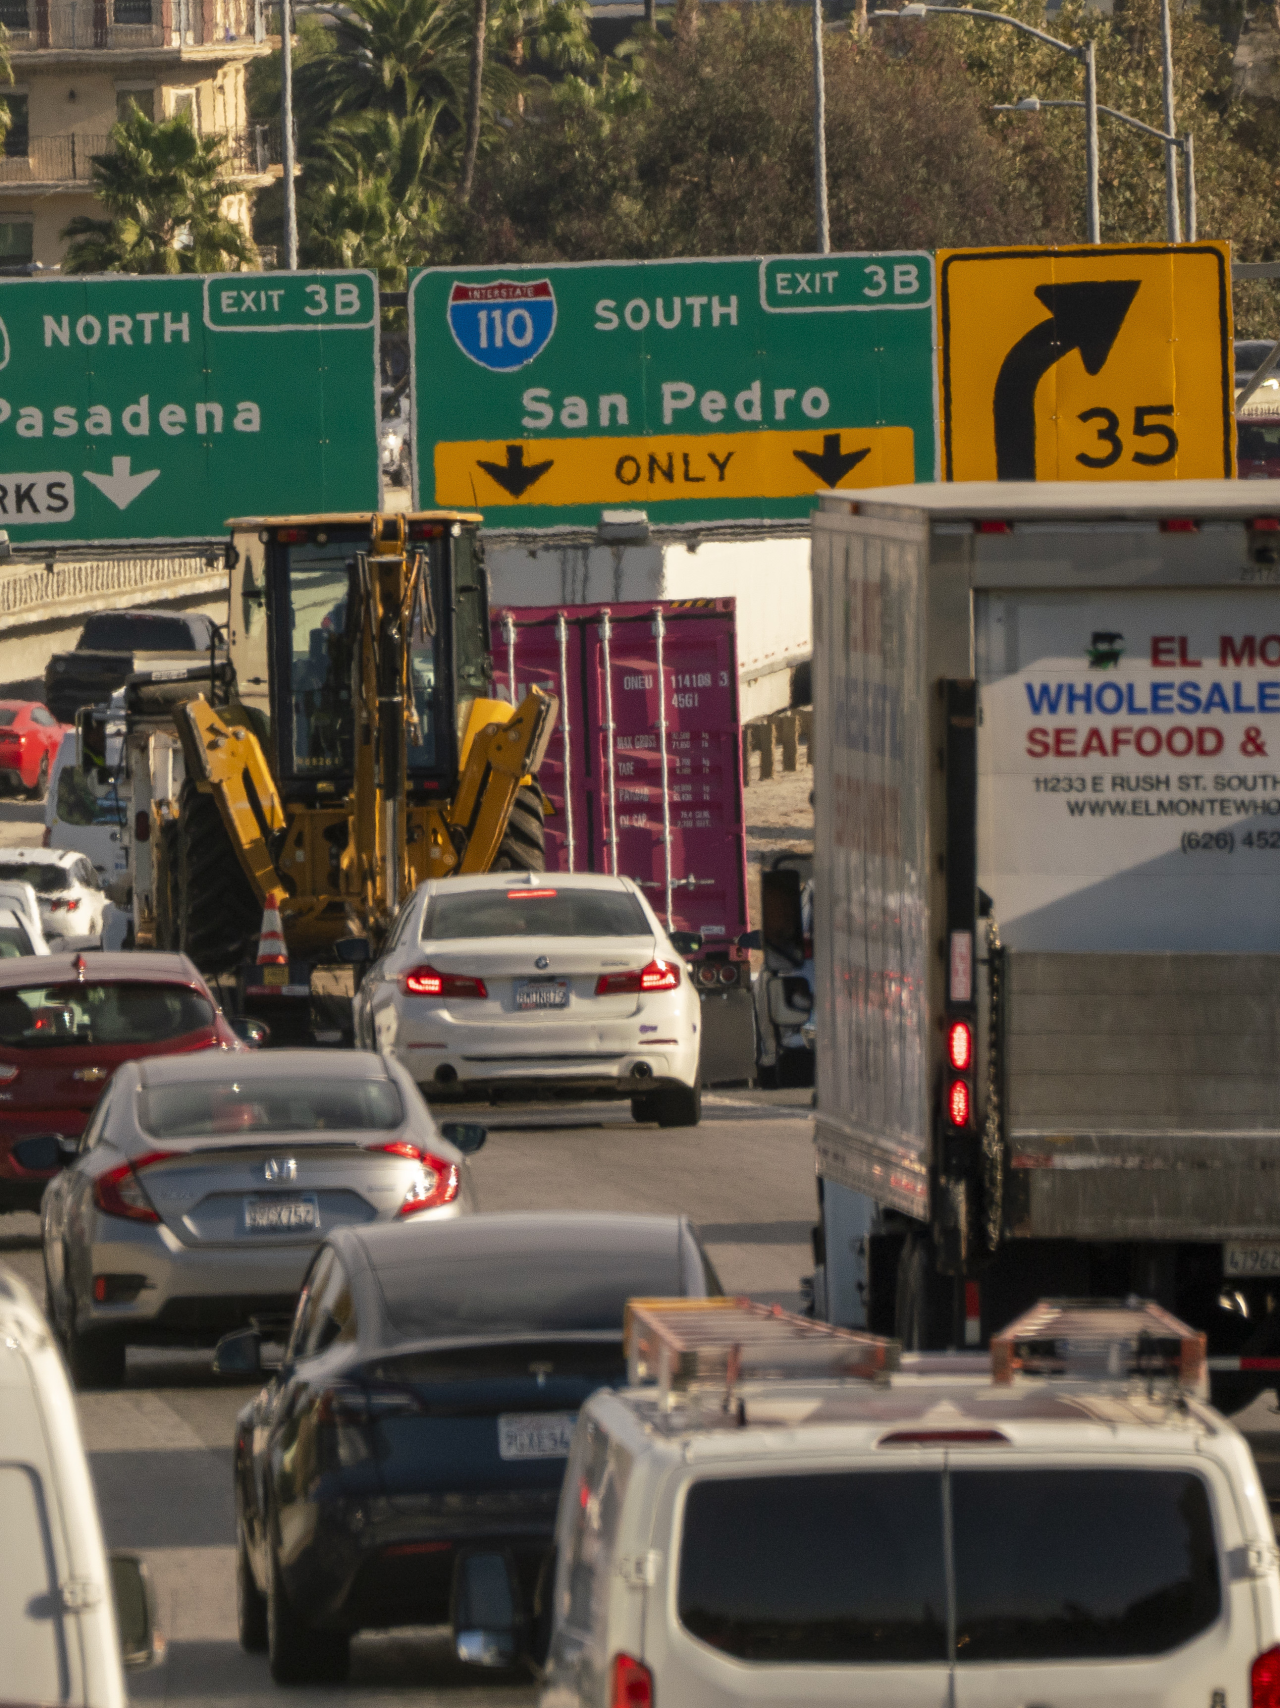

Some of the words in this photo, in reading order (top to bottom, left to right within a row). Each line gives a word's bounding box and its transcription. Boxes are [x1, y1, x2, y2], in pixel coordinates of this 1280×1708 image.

[468, 287, 535, 298] INTERSTATE
[776, 271, 838, 294] EXIT
[863, 264, 919, 297] 3B
[221, 290, 284, 313] EXIT
[305, 283, 360, 316] 3B
[595, 295, 738, 330] SOUTH
[43, 312, 189, 347] NORTH
[478, 308, 533, 348] 110
[522, 388, 629, 429] San
[662, 380, 830, 424] Pedro
[1076, 405, 1178, 468] 35
[615, 452, 733, 485] ONLY
[1151, 635, 1202, 668] EL
[1219, 634, 1280, 668] MO
[624, 676, 653, 690] ONEU
[720, 671, 729, 687] 3
[1025, 681, 1280, 715] WHOLESALE
[1026, 726, 1224, 758] SEAFOOD
[1240, 726, 1268, 757] &
[1033, 777, 1087, 793] 11233
[1091, 776, 1104, 793] E
[1111, 775, 1170, 792] RUSH
[1178, 774, 1207, 792] ST.
[1066, 799, 1280, 816] WWW.ELMONTEWHO
